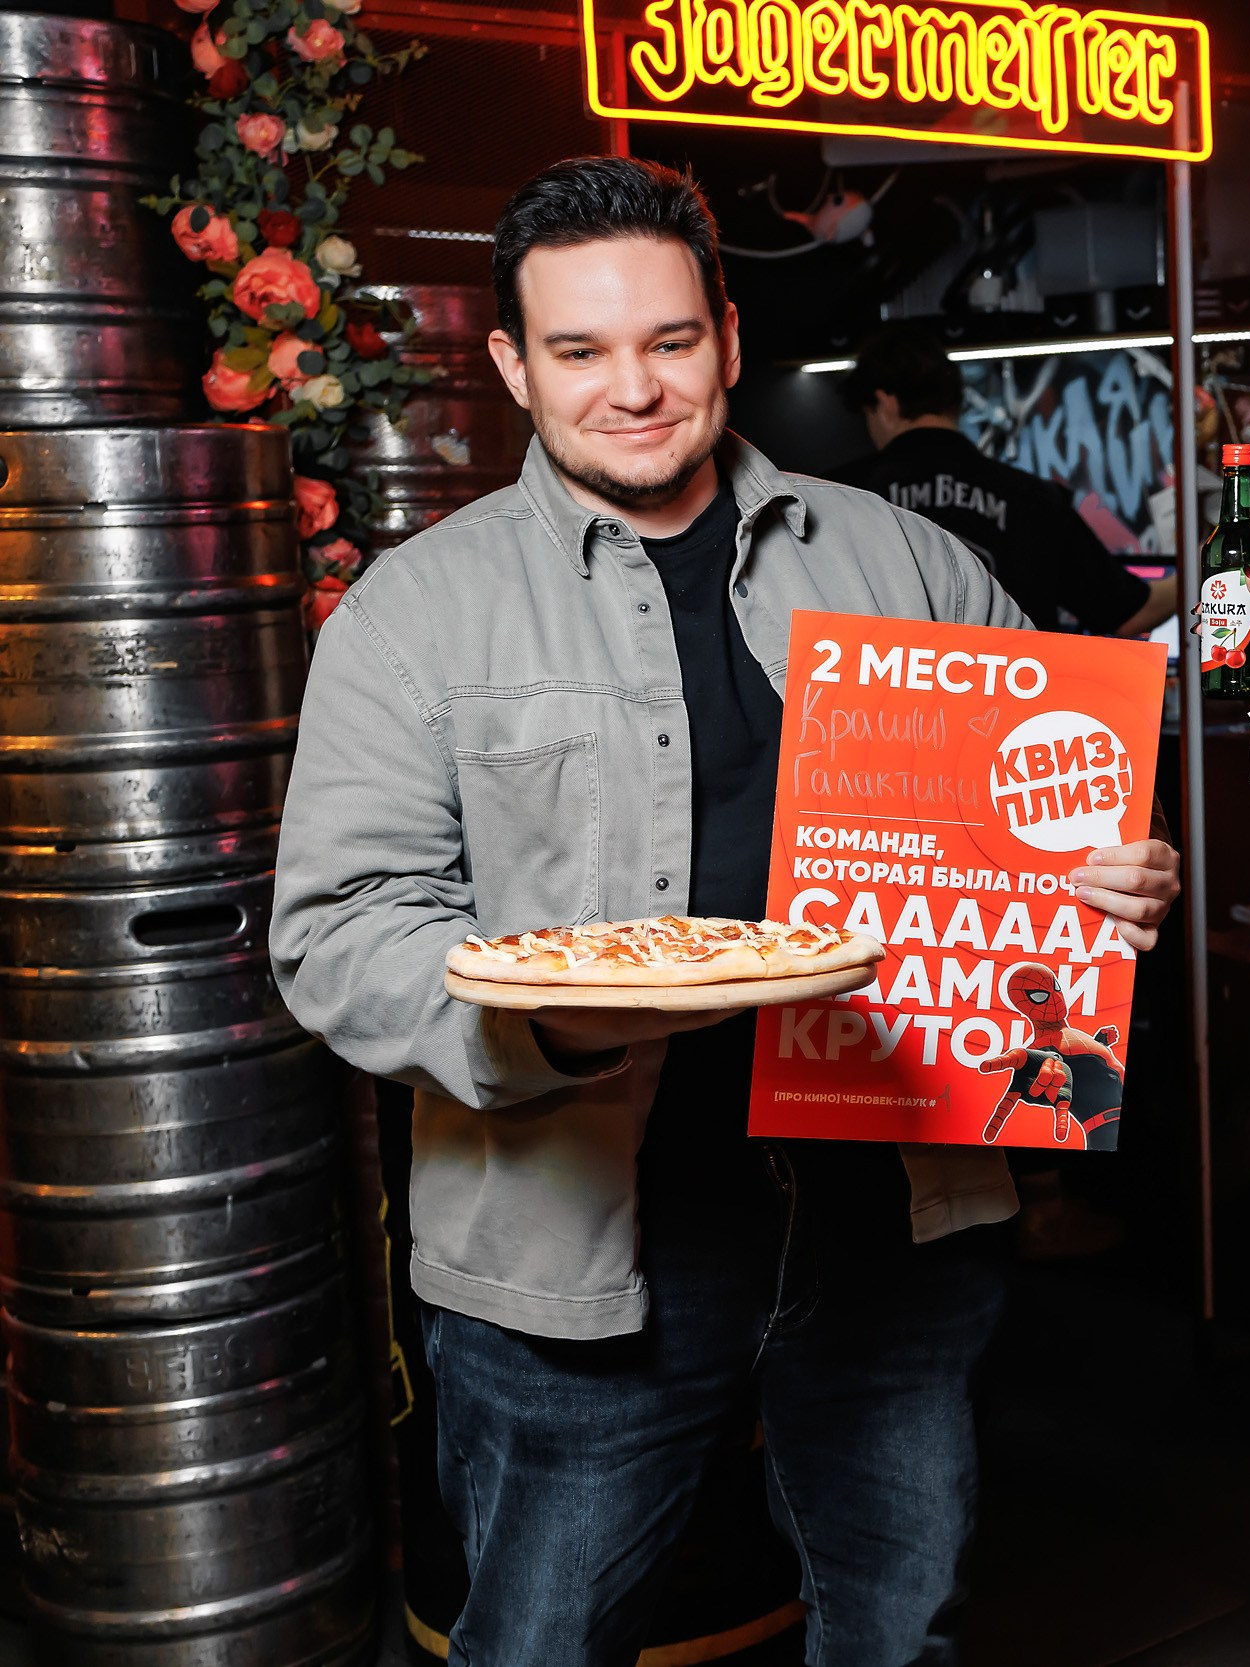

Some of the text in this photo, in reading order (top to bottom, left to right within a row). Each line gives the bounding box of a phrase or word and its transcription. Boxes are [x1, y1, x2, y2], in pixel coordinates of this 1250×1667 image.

[935, 473, 1007, 531] BEAM
[811, 640, 1048, 700] 2 МЕСТО
[794, 750, 979, 809] Галактики
[992, 731, 1128, 788] КВИЗ,
[995, 771, 1130, 829] ПЛИЗ!
[795, 826, 944, 860] КОМАНДЕ,
[793, 857, 1076, 896] КОТОРАЯ БЫЛА ПОЧ
[774, 1090, 802, 1102] [ПРО
[804, 1092, 840, 1104] КИНО]
[842, 1094, 927, 1108] ЧЕЛОВЕК-ПАУК
